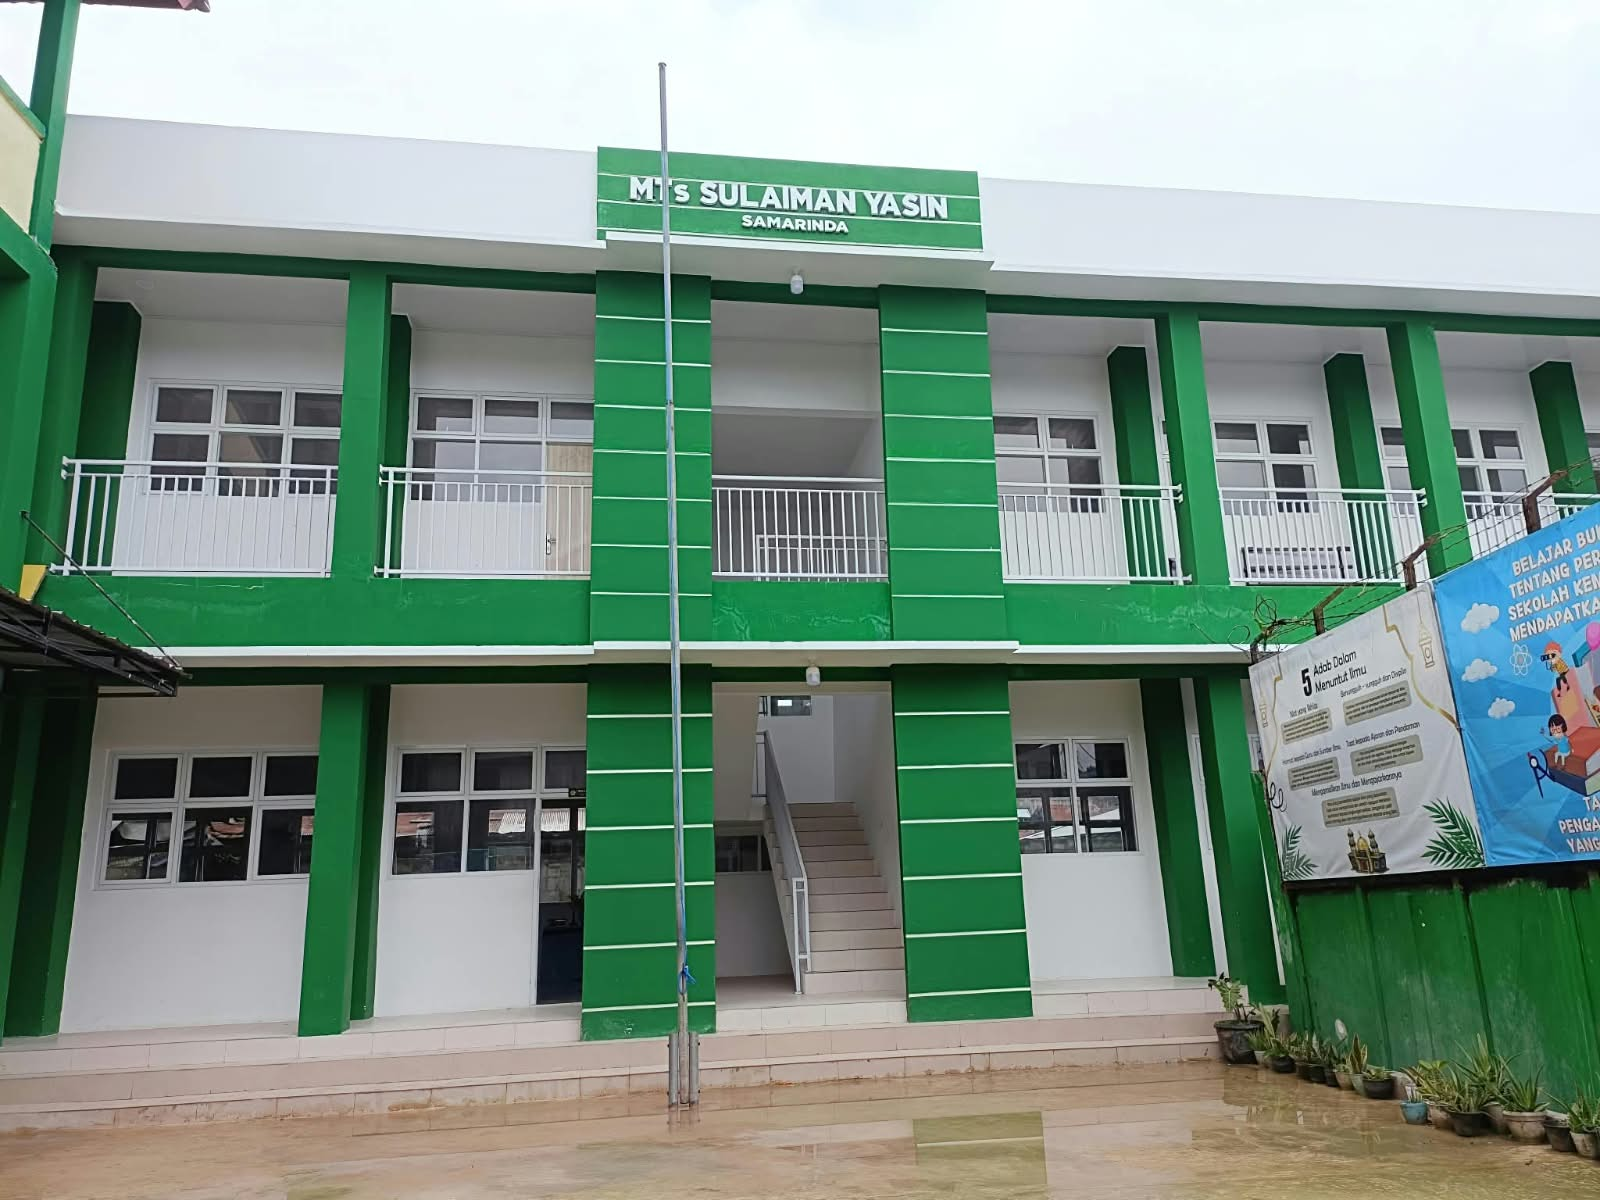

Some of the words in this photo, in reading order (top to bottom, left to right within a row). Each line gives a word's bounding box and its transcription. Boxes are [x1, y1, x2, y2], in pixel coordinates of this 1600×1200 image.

[629, 176, 690, 203] MTs
[700, 181, 856, 216] SULAIMAN
[863, 190, 948, 219] YASIN
[741, 214, 849, 233] SAMARINDA
[1512, 538, 1573, 577] BELAJAR
[1508, 562, 1570, 599] TENTANG
[1508, 584, 1570, 621] SEKOLAH
[1313, 659, 1332, 678] Adab
[1332, 650, 1357, 668] Dalam
[1314, 670, 1349, 694] Menuntut
[1349, 665, 1367, 680] Ilmu
[1301, 668, 1313, 697] 5
